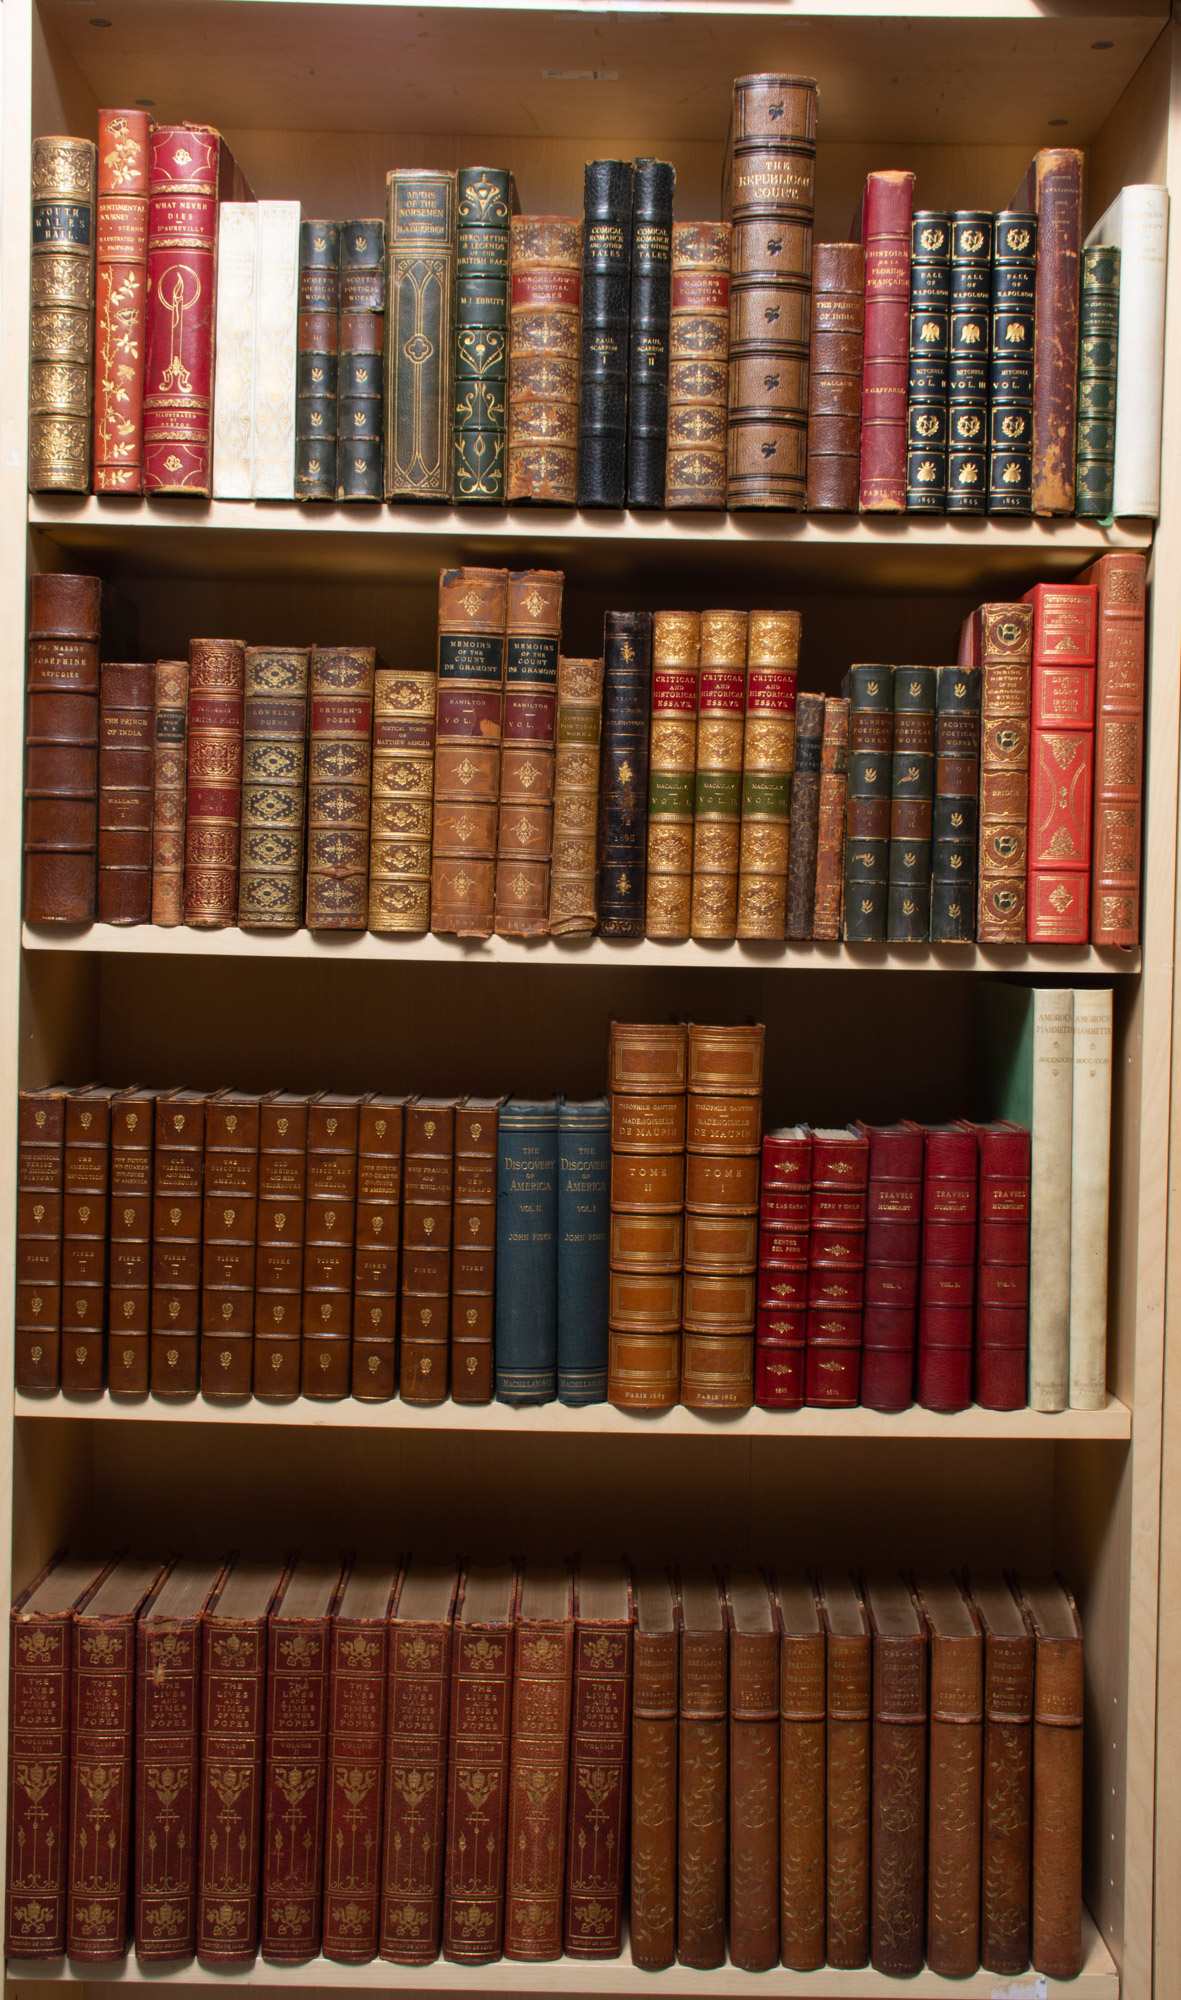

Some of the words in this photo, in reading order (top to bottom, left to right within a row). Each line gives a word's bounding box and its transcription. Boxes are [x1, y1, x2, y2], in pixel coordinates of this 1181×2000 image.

[766, 161, 789, 170] THE
[181, 202, 207, 210] NEVER
[421, 200, 436, 208] THE
[40, 207, 79, 216] SOUTH
[400, 209, 443, 217] NORSEMEN
[36, 218, 85, 228] WALES
[870, 250, 908, 258] HISTOIRE
[603, 356, 606, 364] I
[649, 357, 654, 365] II
[514, 643, 554, 651] MEMOIRS
[34, 657, 87, 666] JOSÉPHINE
[703, 674, 742, 682] CRITICAL
[749, 691, 794, 699] HISTORICAL
[710, 1130, 750, 1138] MAUPIN
[504, 1158, 555, 1171] DISCOVERY
[630, 1169, 667, 1177] TOME
[705, 1169, 742, 1178] TOME
[510, 1180, 551, 1191] AMERICA
[566, 1180, 606, 1192] AMERICA
[644, 1184, 652, 1192] II
[721, 1184, 725, 1192] I
